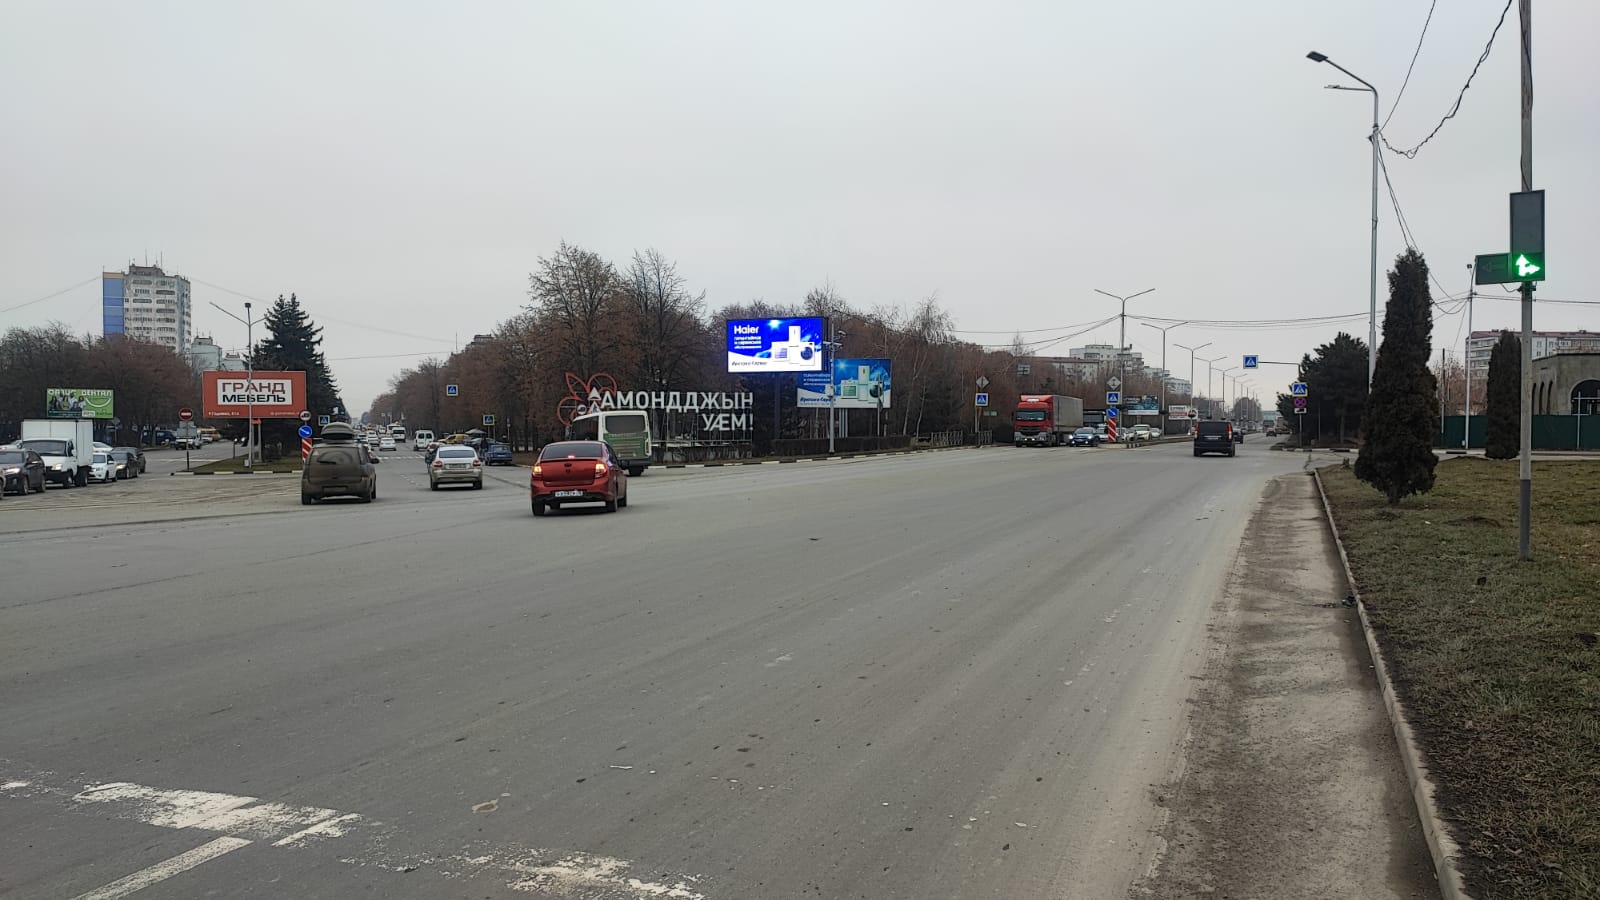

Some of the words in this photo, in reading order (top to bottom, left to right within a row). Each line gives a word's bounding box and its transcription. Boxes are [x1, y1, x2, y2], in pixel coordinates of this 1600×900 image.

[734, 324, 759, 335] Haier
[222, 382, 286, 395] ГРАНД
[222, 394, 286, 403] МЕБЕЛЬ
